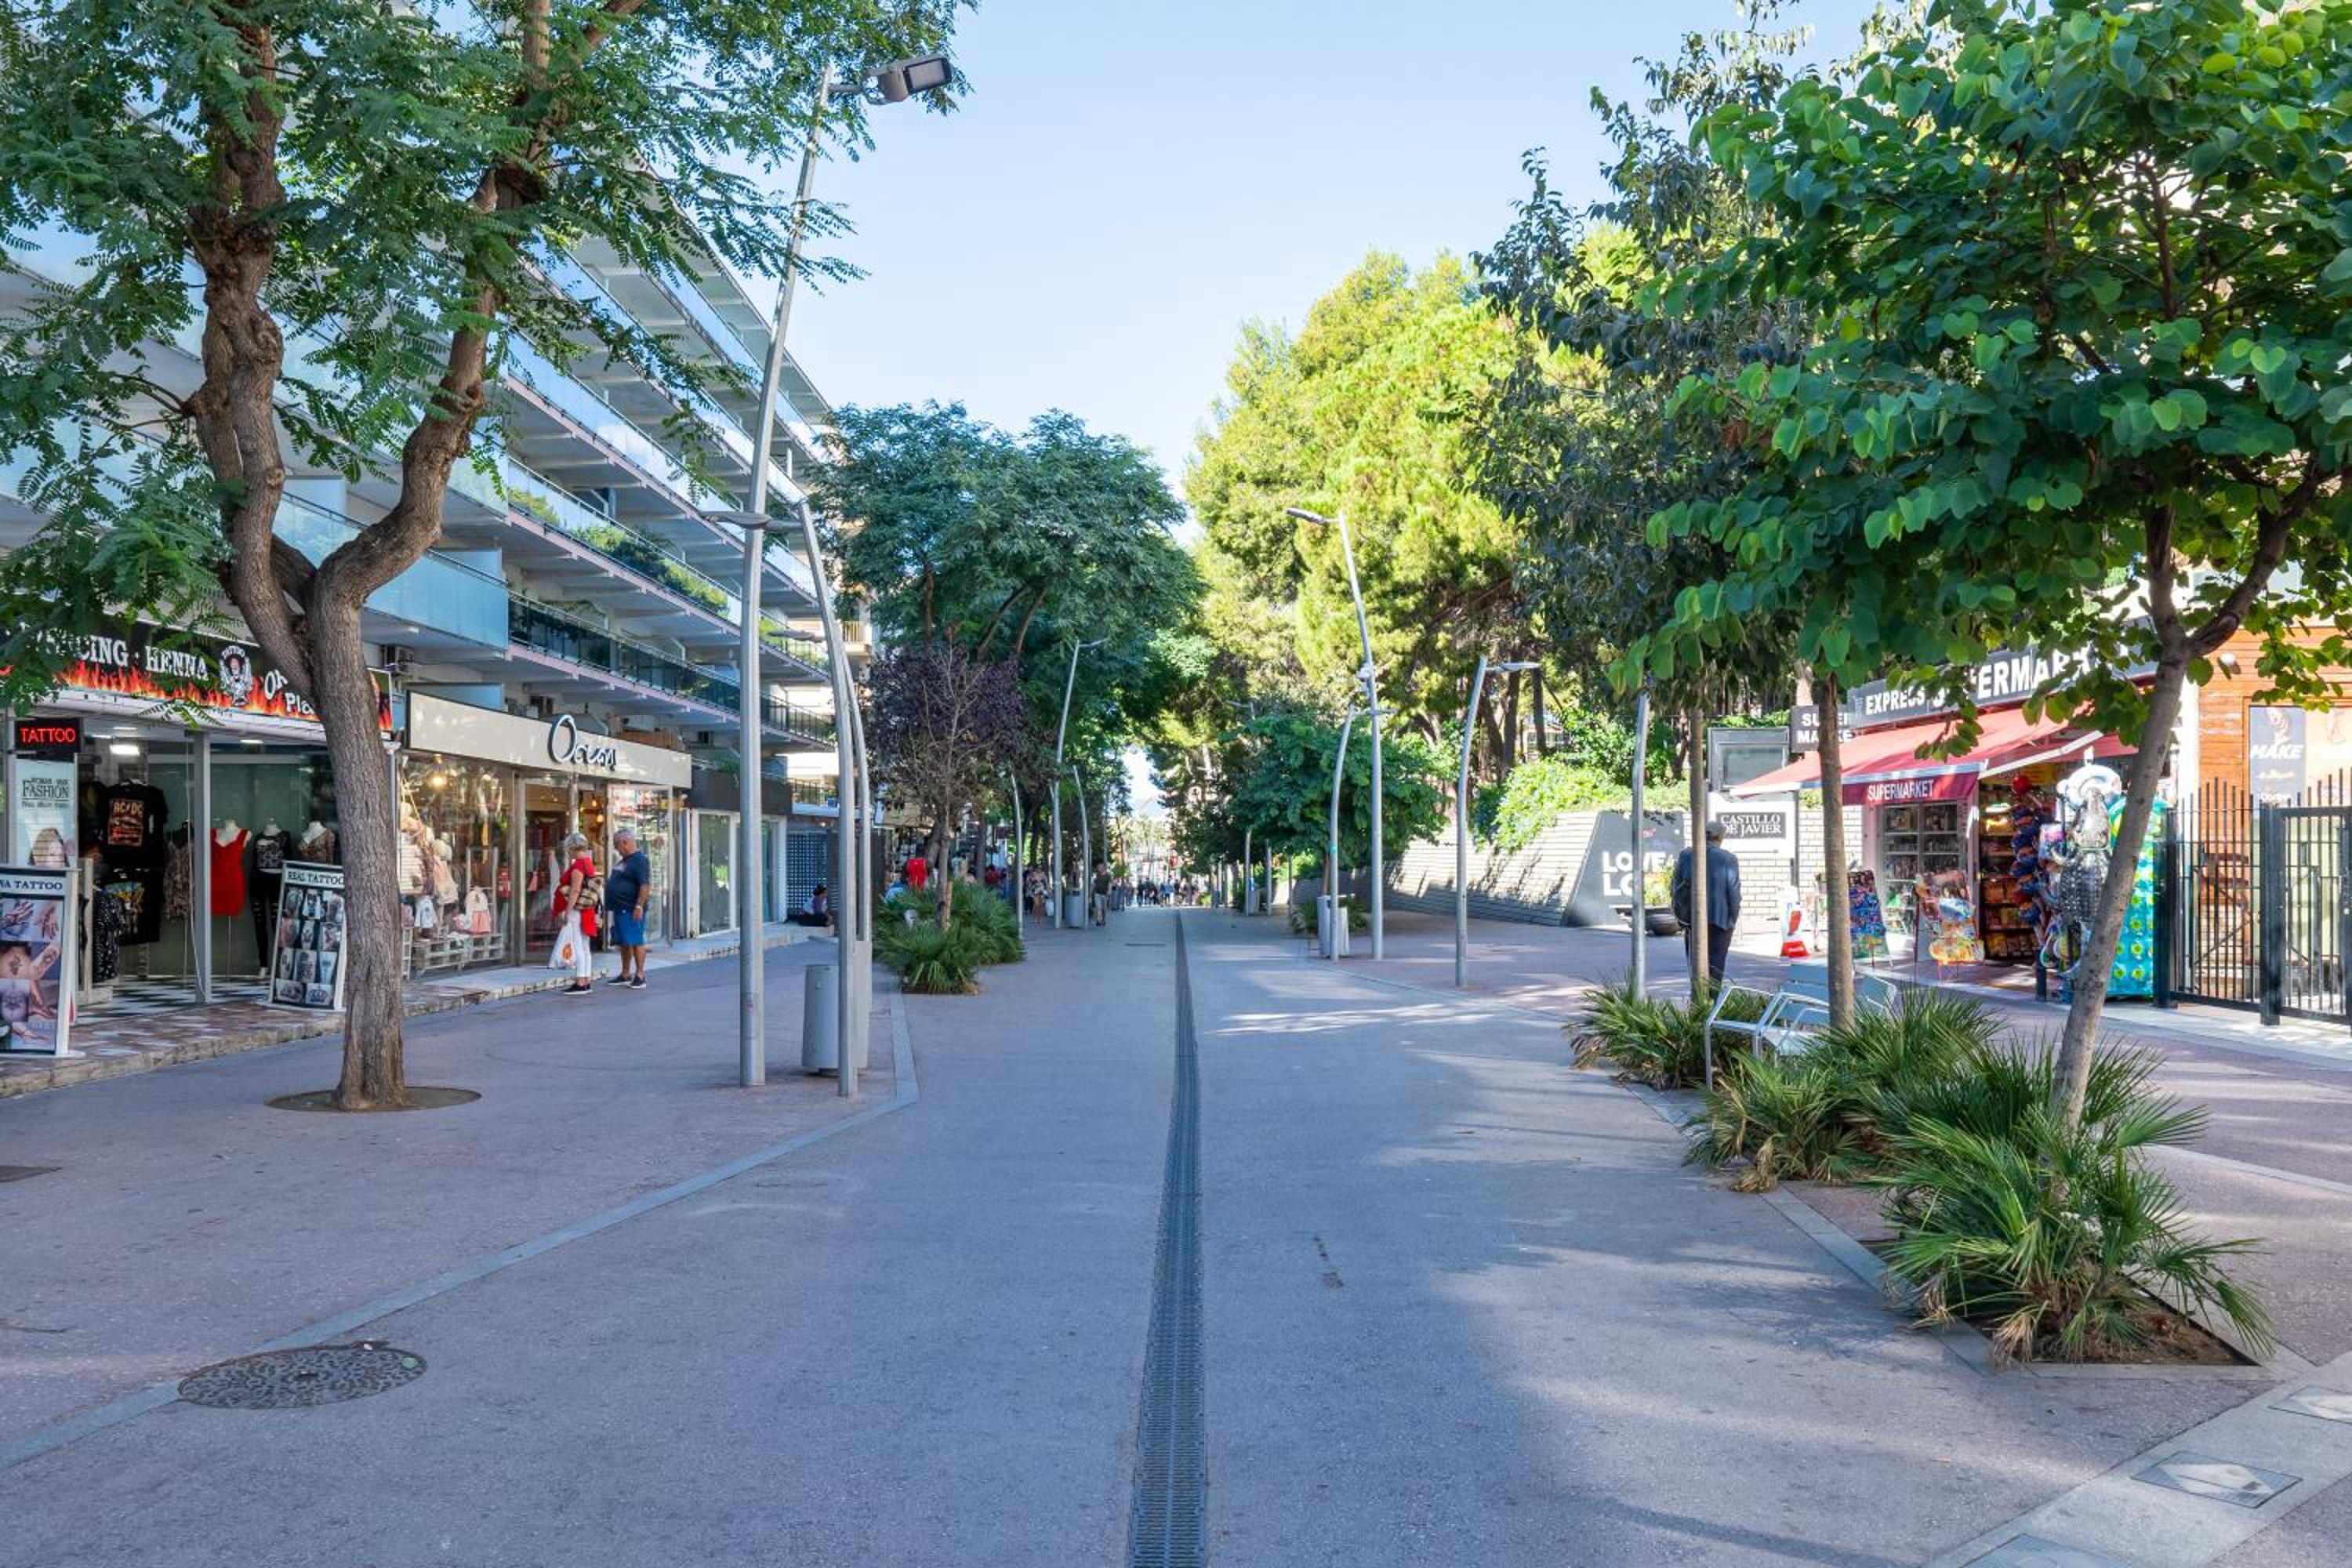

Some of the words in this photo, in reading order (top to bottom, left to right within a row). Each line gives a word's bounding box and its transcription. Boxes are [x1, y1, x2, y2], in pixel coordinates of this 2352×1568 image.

[144, 645, 209, 681] HENNA
[20, 727, 76, 743] TATTOO
[22, 779, 69, 798] FASHION
[1867, 779, 1934, 800] SUPERMARKET
[1721, 815, 1780, 825] CASTILLO
[1740, 824, 1782, 837] JAVIER
[14, 880, 63, 891] TATTOO
